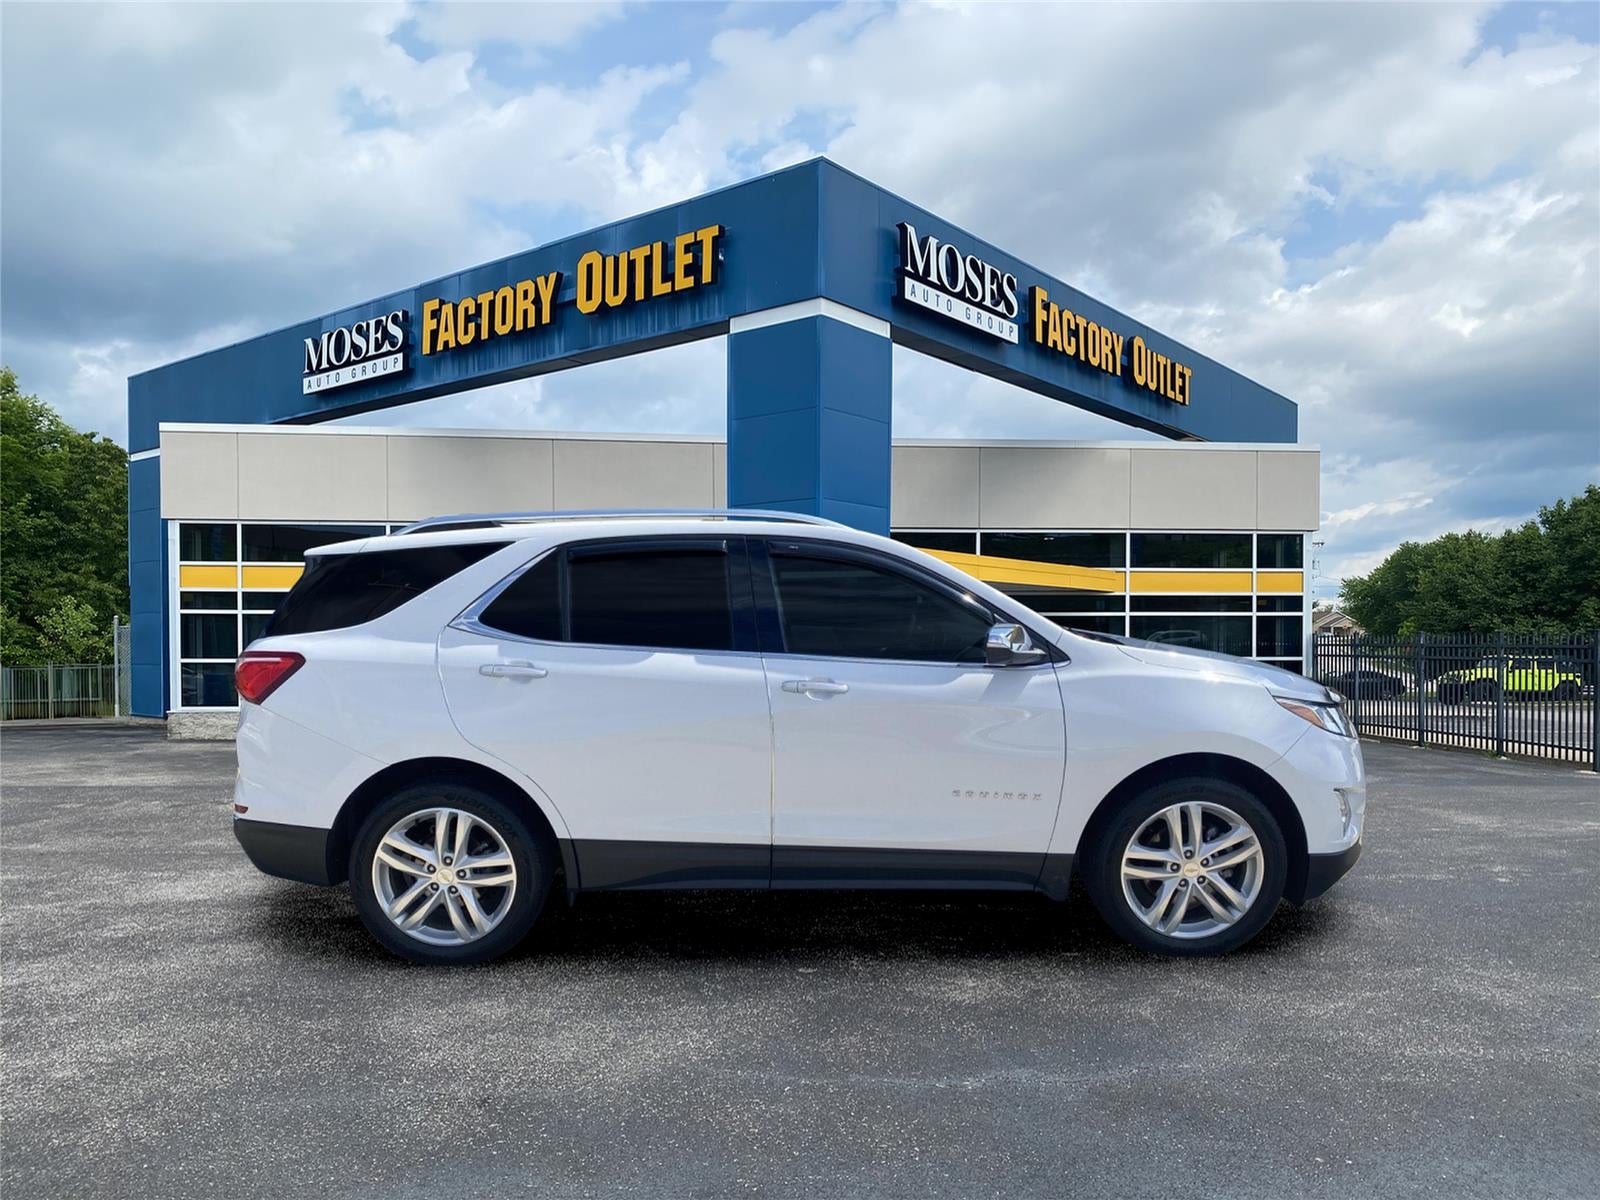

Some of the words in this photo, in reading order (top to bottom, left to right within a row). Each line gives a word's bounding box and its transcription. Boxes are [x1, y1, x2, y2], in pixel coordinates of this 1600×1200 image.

[421, 271, 559, 356] FACTORY
[576, 224, 720, 315] OUTLET
[904, 222, 1018, 318] MOSES
[303, 310, 404, 374] MOSES
[910, 284, 953, 313] AUTO
[965, 307, 1014, 337] GROUP
[1034, 285, 1124, 377] FACTORY
[1132, 335, 1192, 407] OUTLET
[307, 372, 340, 390] AUTO
[351, 357, 399, 379] GROUP
